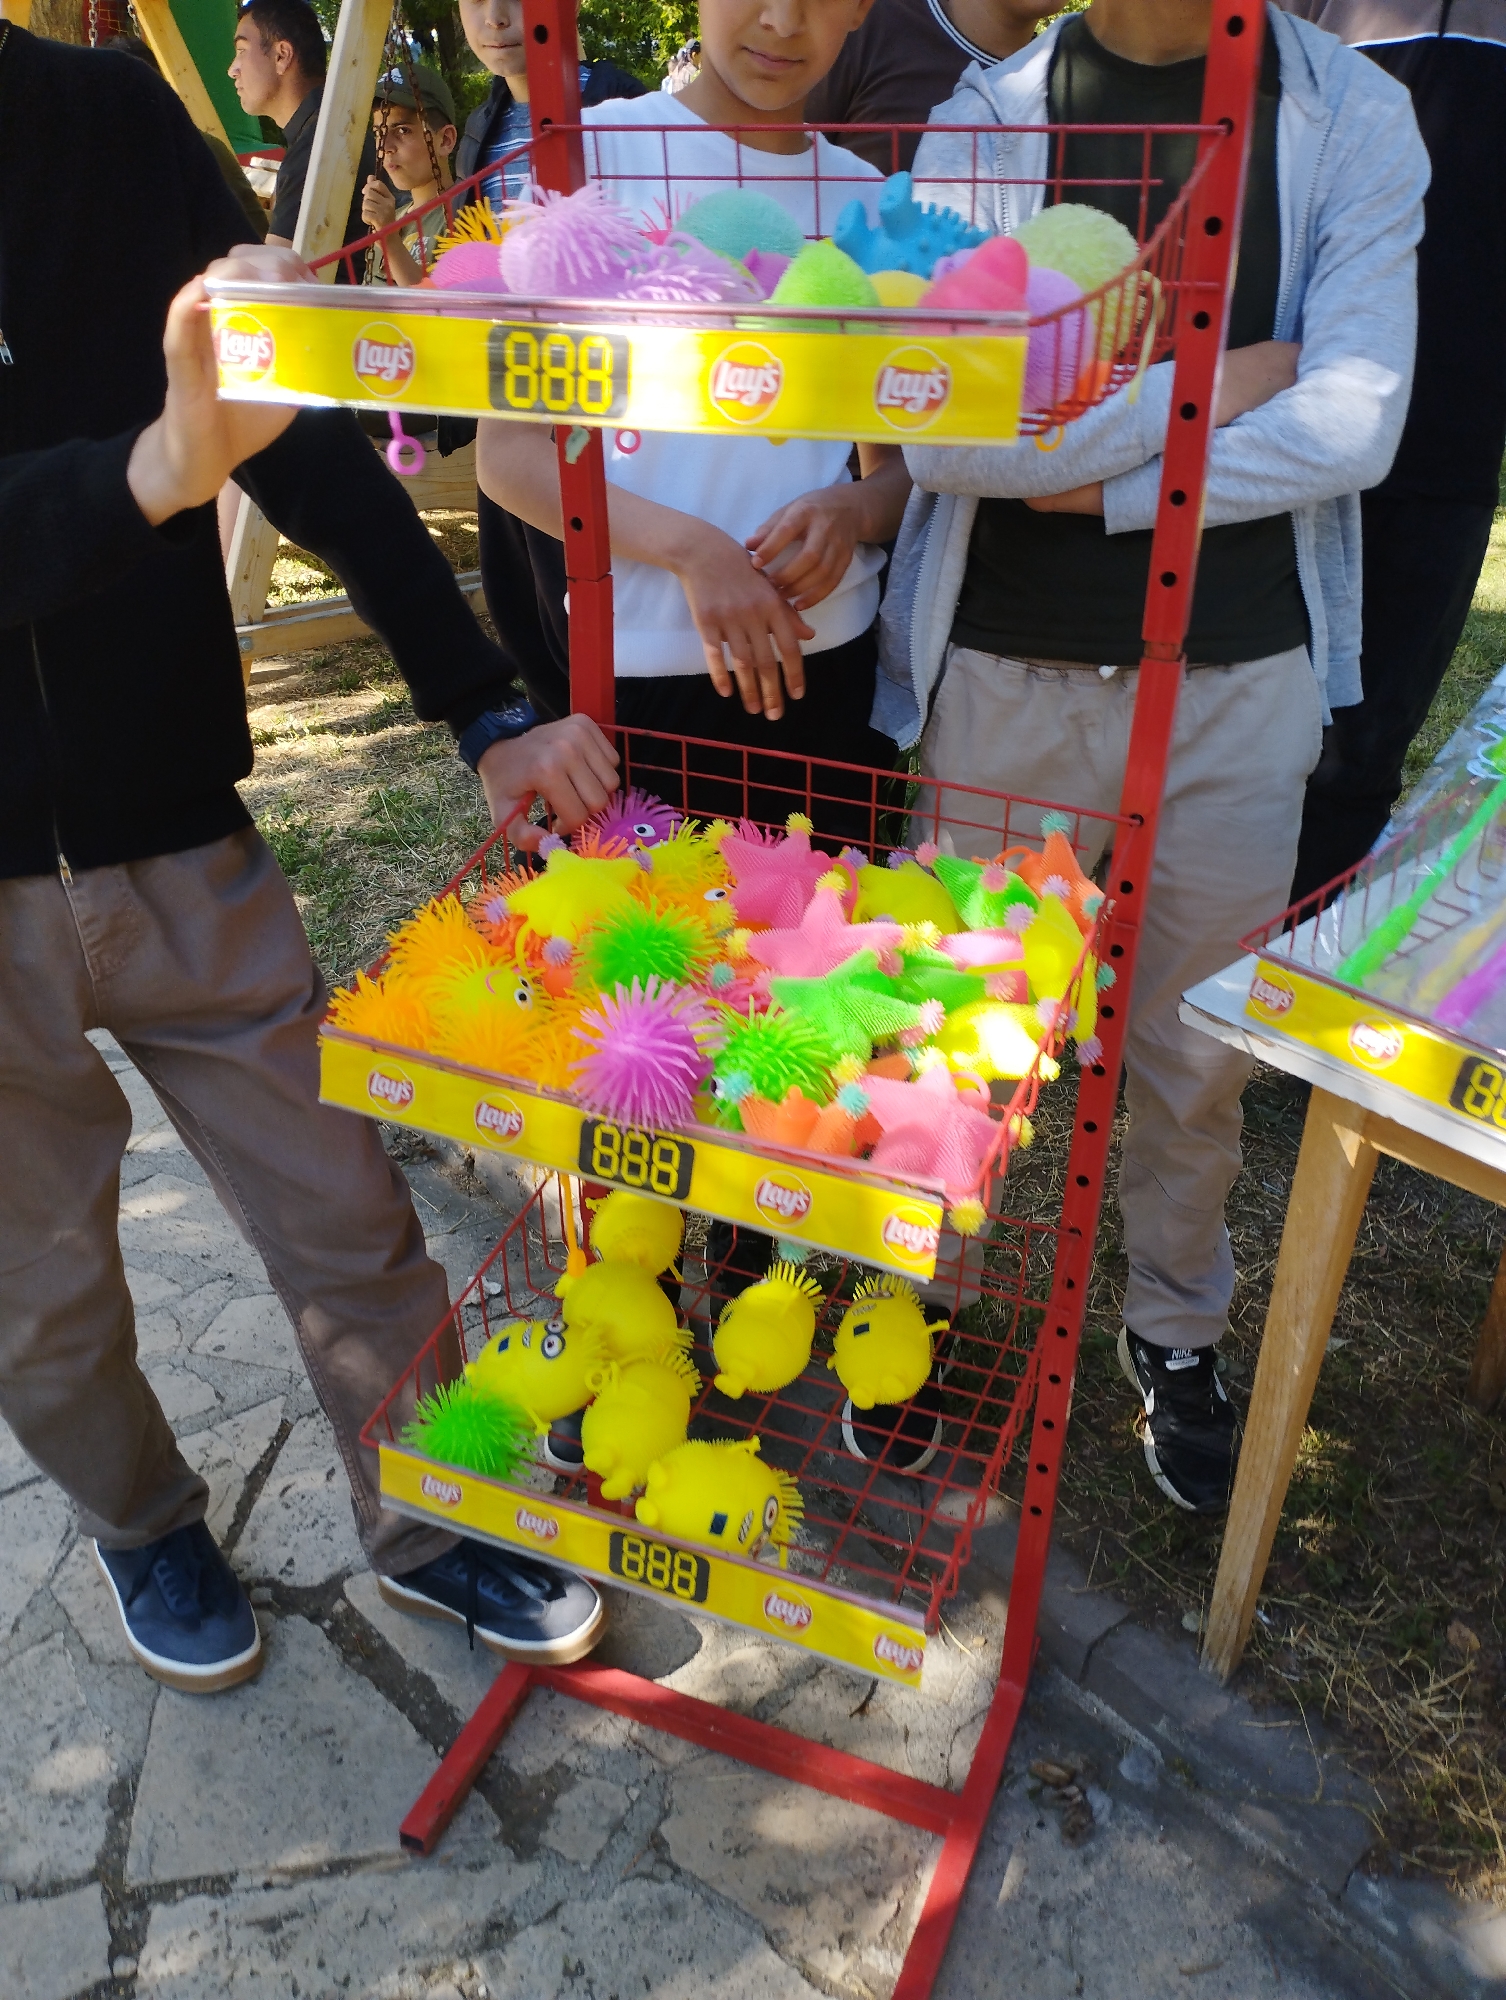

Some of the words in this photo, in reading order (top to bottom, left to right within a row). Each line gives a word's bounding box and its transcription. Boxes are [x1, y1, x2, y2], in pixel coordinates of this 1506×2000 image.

[219, 328, 271, 370] Lay's
[356, 338, 412, 381] Lay's
[504, 330, 614, 415] 888
[714, 360, 780, 406] Lay's
[878, 364, 947, 413] Lay's
[370, 1070, 413, 1105] Lay's
[478, 1102, 523, 1137] Lay's
[592, 1121, 681, 1197] 888
[757, 1178, 810, 1217] Lay's
[885, 1214, 940, 1254] Lay's
[1171, 1347, 1193, 1360] NIKE
[421, 1473, 463, 1504] Lay's
[517, 1508, 559, 1538] Lay's
[621, 1534, 698, 1600] 888
[765, 1592, 812, 1627] Lay's
[876, 1633, 923, 1670] Lay's
